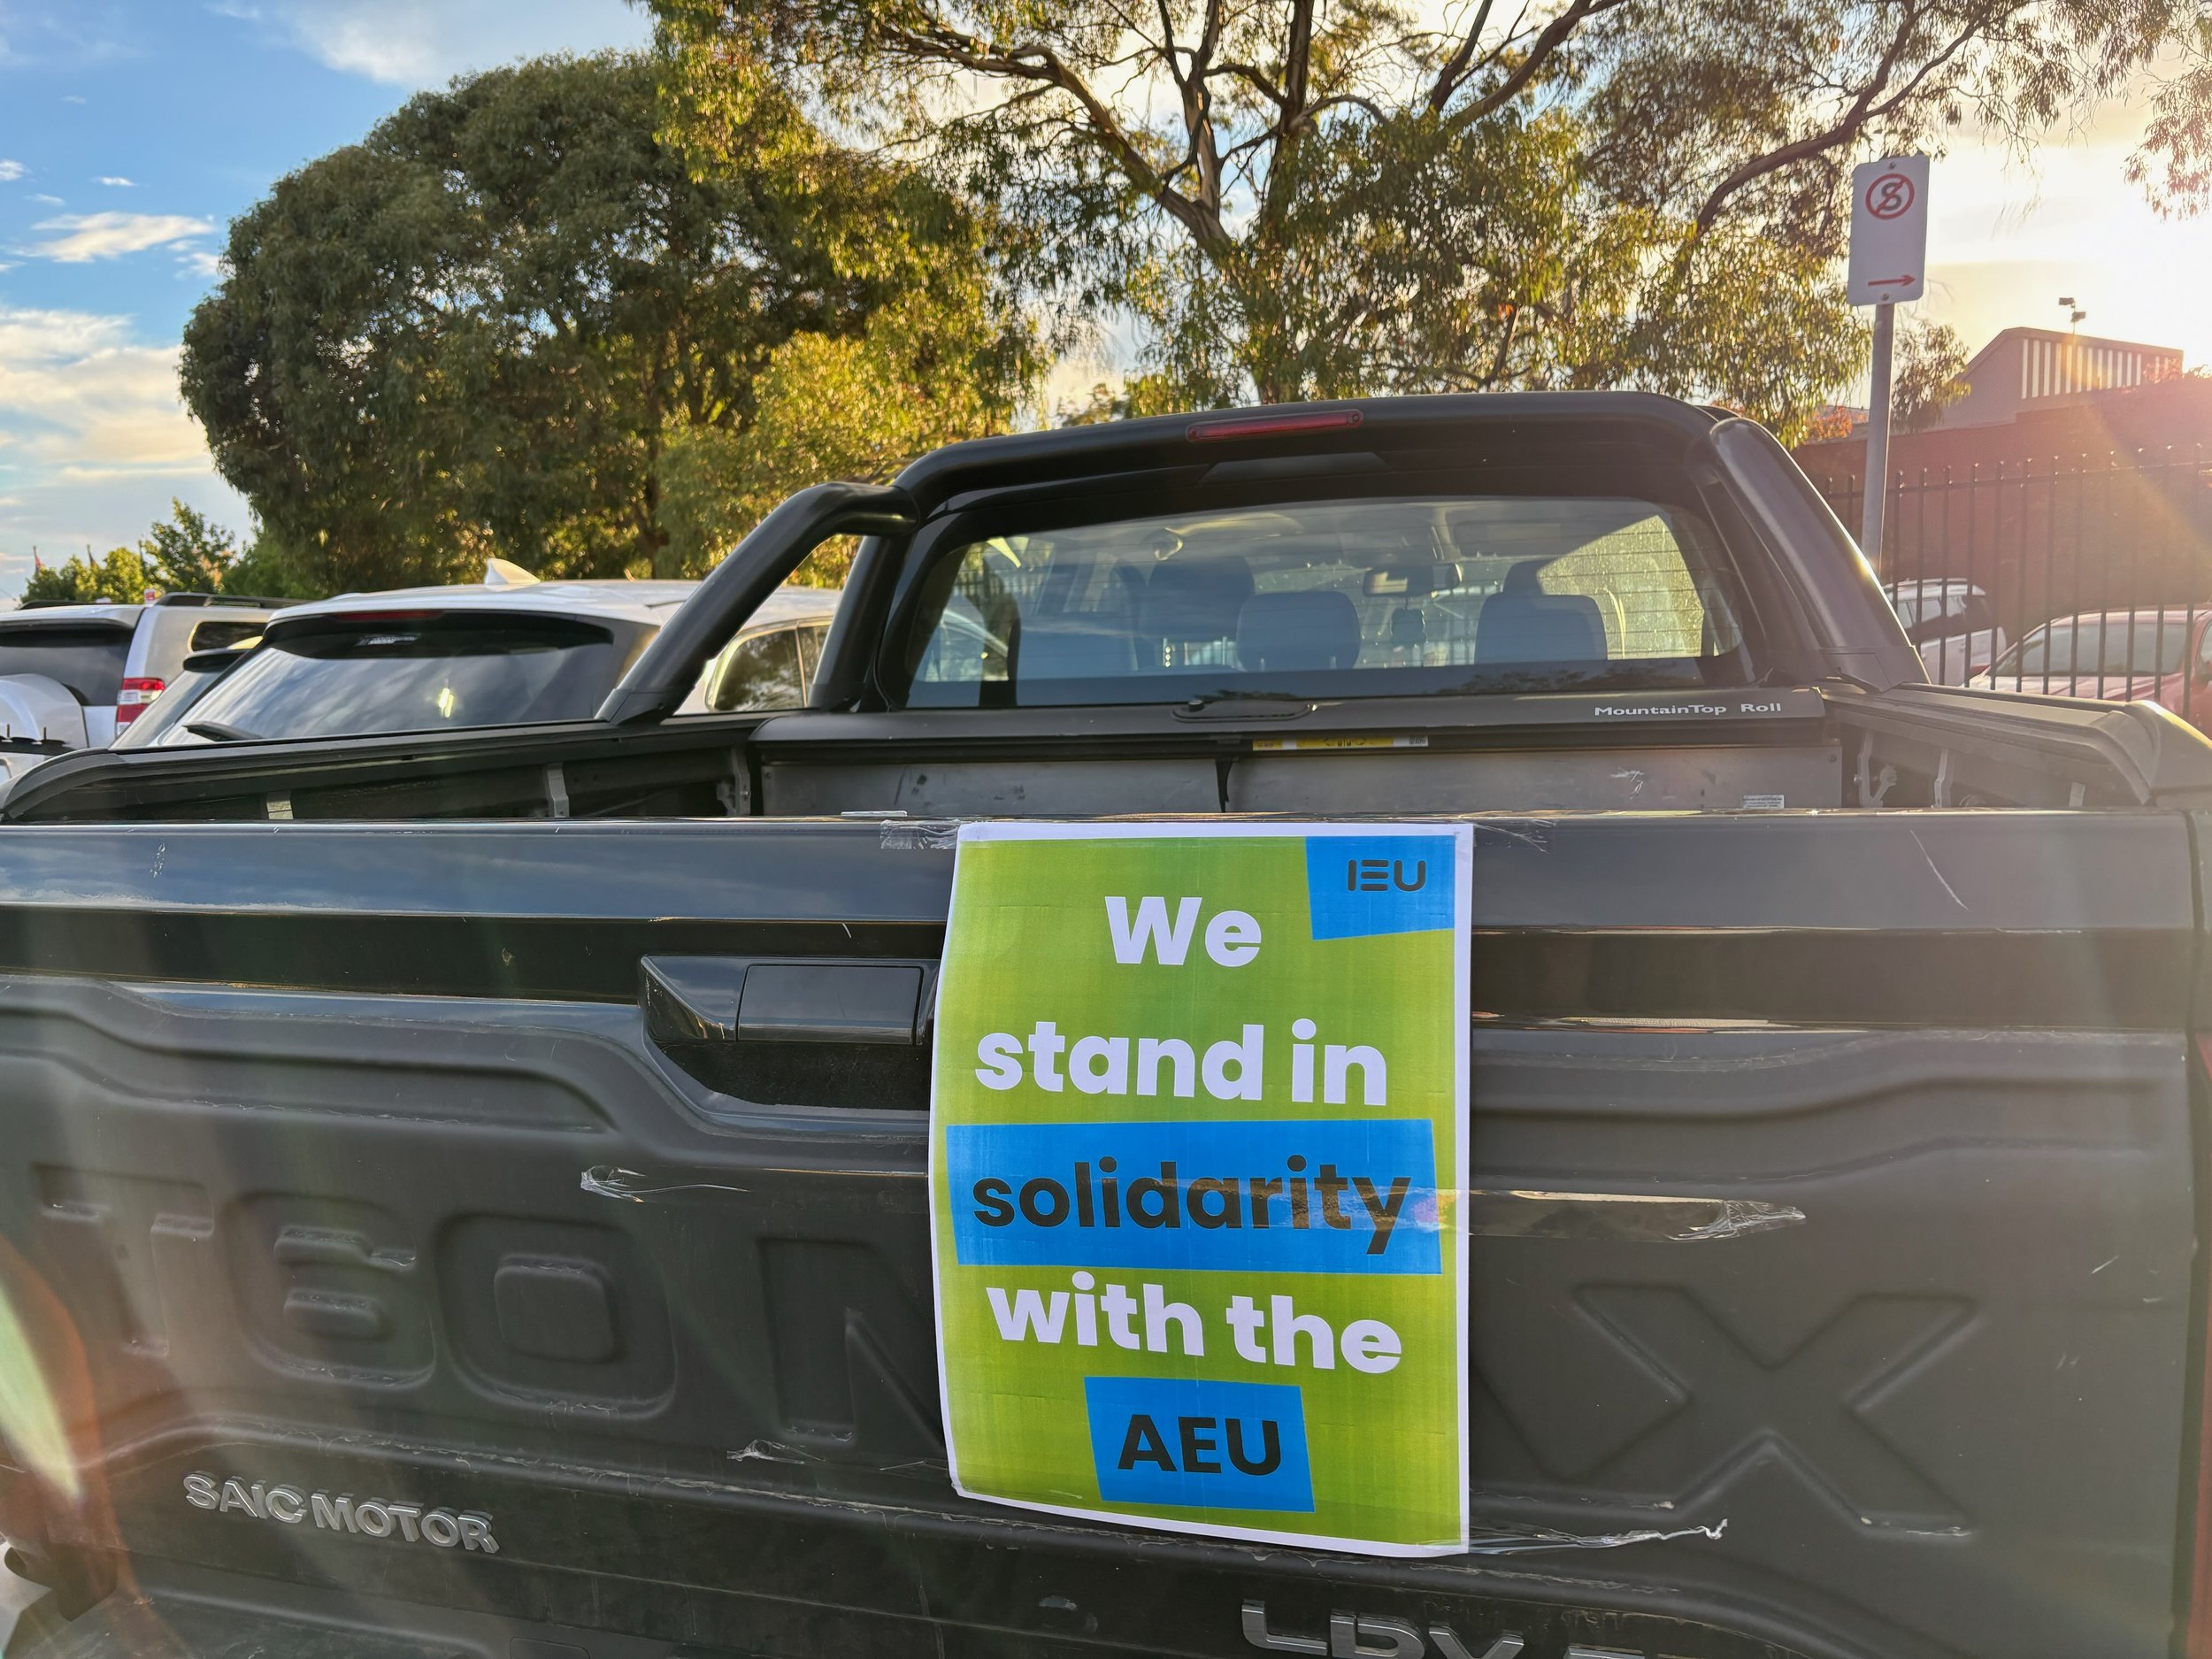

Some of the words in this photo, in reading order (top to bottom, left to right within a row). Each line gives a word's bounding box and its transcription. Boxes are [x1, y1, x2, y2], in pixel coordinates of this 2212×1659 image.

[1594, 704, 1727, 716] MountainTop
[1740, 703, 1782, 712] Roll
[1348, 859, 1426, 892] IEU
[1104, 896, 1262, 967] We
[975, 1021, 1263, 1101] stand
[1291, 1018, 1387, 1106] in
[972, 1155, 1411, 1255] solidarity
[986, 1271, 1204, 1356] with
[1226, 1294, 1402, 1374] the
[1118, 1414, 1281, 1476] AEU
[311, 1488, 501, 1555] MOTOR
